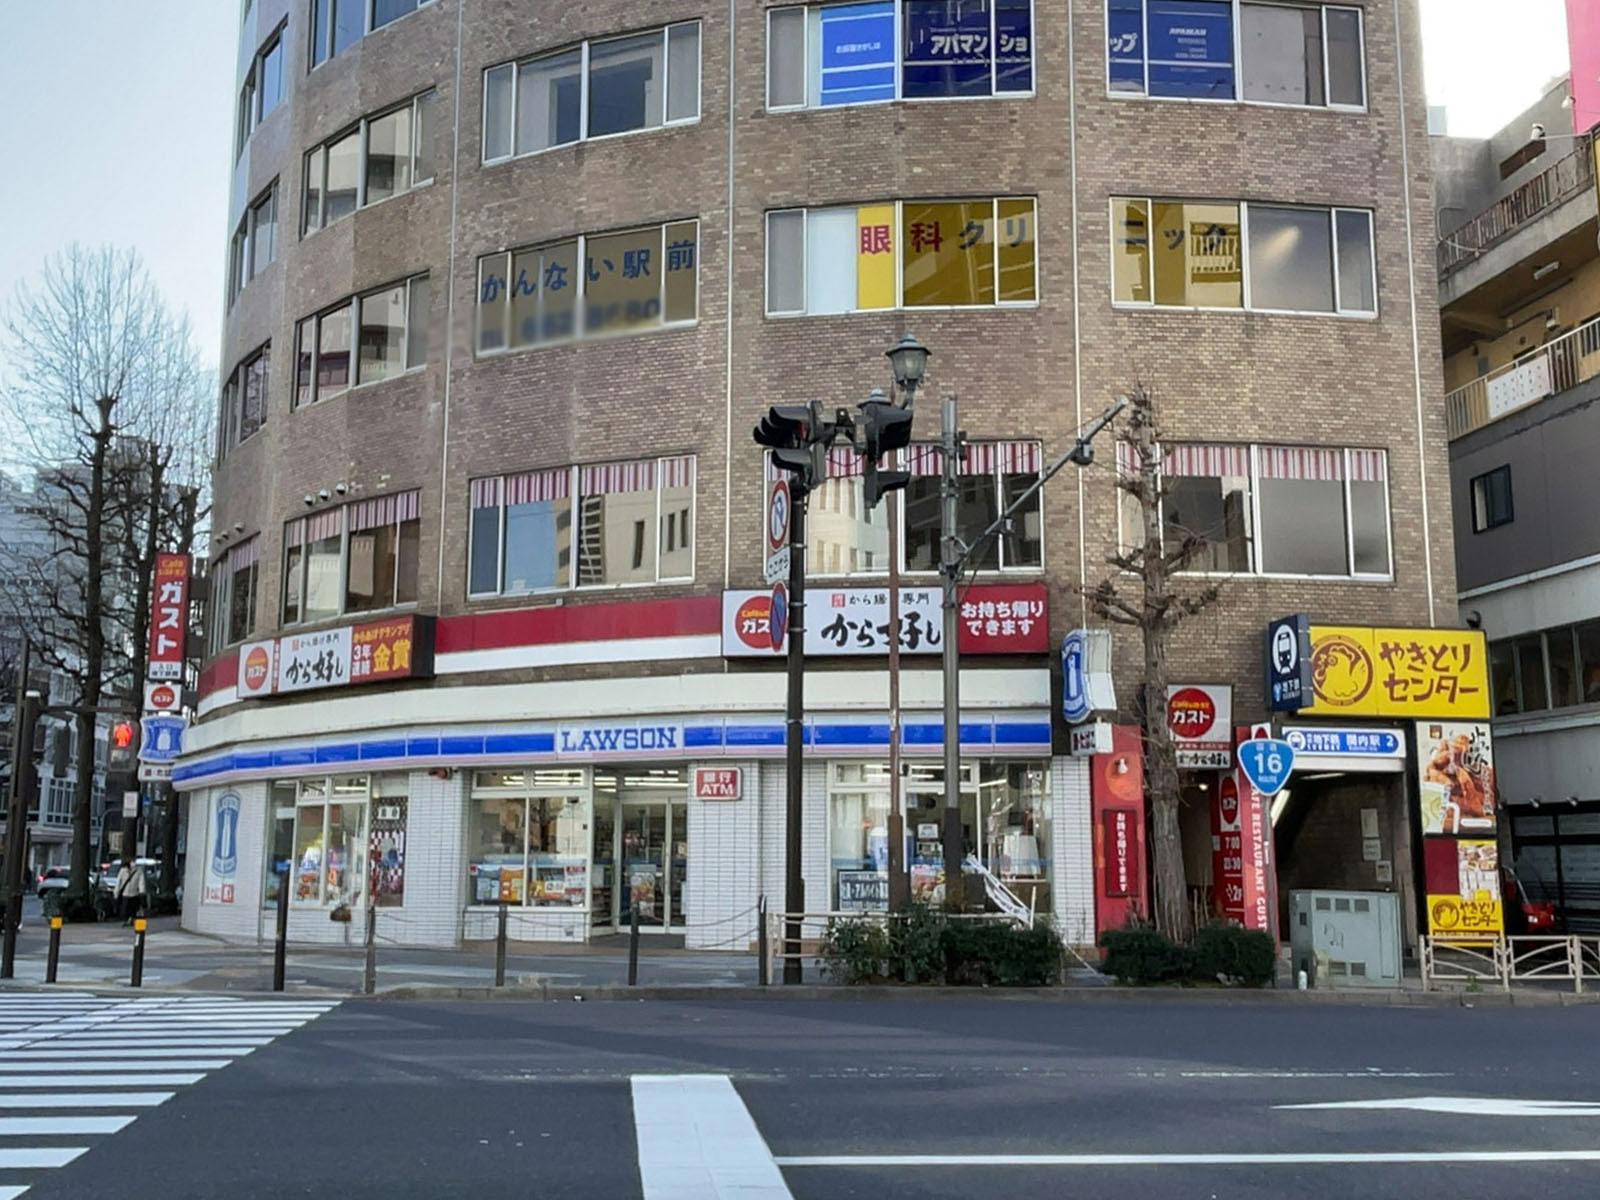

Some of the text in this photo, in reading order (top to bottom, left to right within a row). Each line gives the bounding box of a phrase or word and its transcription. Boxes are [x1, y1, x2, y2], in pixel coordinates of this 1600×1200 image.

[481, 239, 696, 302] かんない駅前
[157, 581, 184, 656] ガスト
[960, 600, 1043, 619] お持ち帰り
[741, 618, 770, 634] ガス
[966, 618, 1034, 637] できます
[286, 649, 344, 685] から好し
[1379, 641, 1471, 672] やきとり
[1383, 672, 1479, 703] センター
[1173, 710, 1211, 724] ガスト
[562, 727, 677, 752] LAWSON
[1386, 735, 1395, 748] 2
[1253, 752, 1283, 774] 16
[701, 783, 734, 796] ATM
[1251, 813, 1266, 892] RESTAURANT
[1255, 897, 1268, 931] GUST
[1460, 902, 1496, 916] やきとり
[1461, 914, 1499, 927] センター
